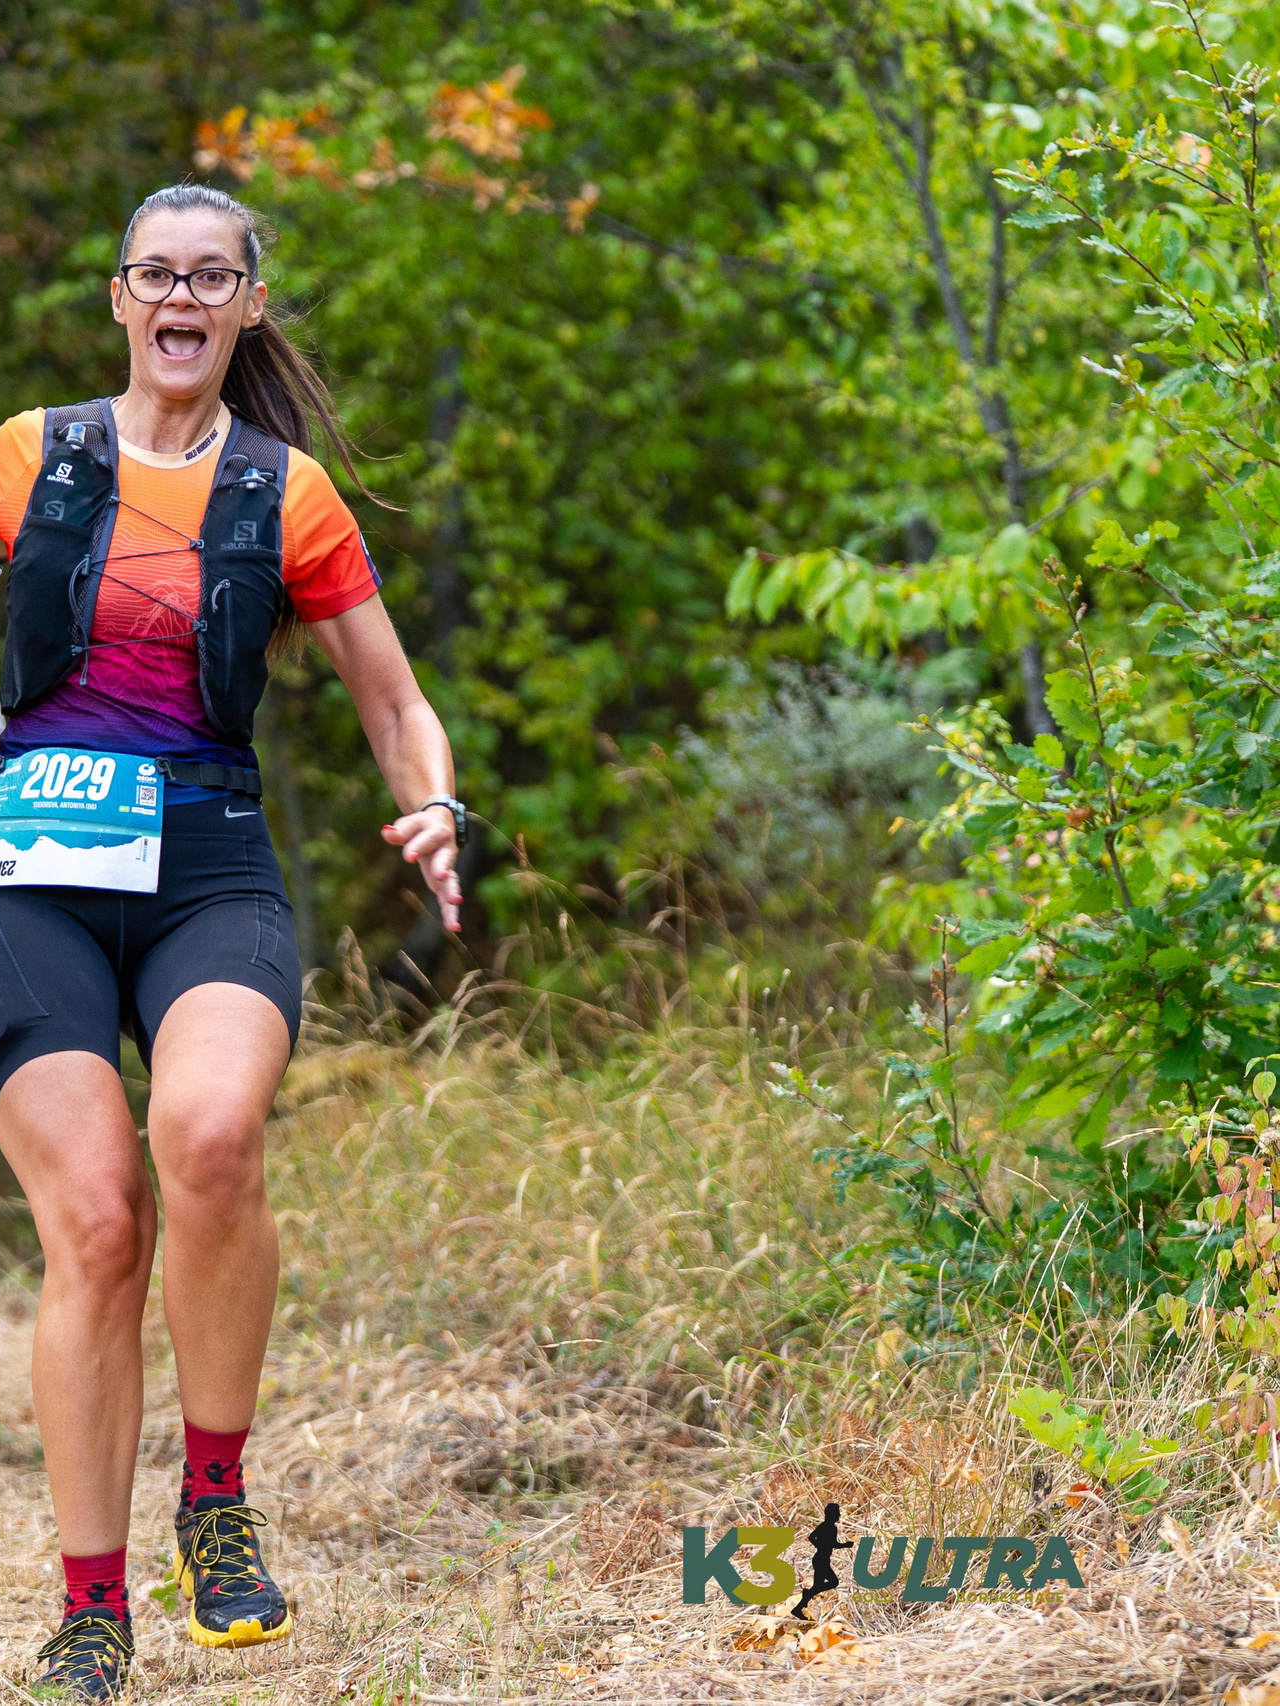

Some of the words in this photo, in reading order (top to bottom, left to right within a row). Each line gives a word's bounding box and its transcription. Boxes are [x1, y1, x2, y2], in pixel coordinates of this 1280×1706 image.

[185, 449, 198, 460] GOLD
[196, 437, 212, 454] BORDER
[20, 753, 116, 801] 2029
